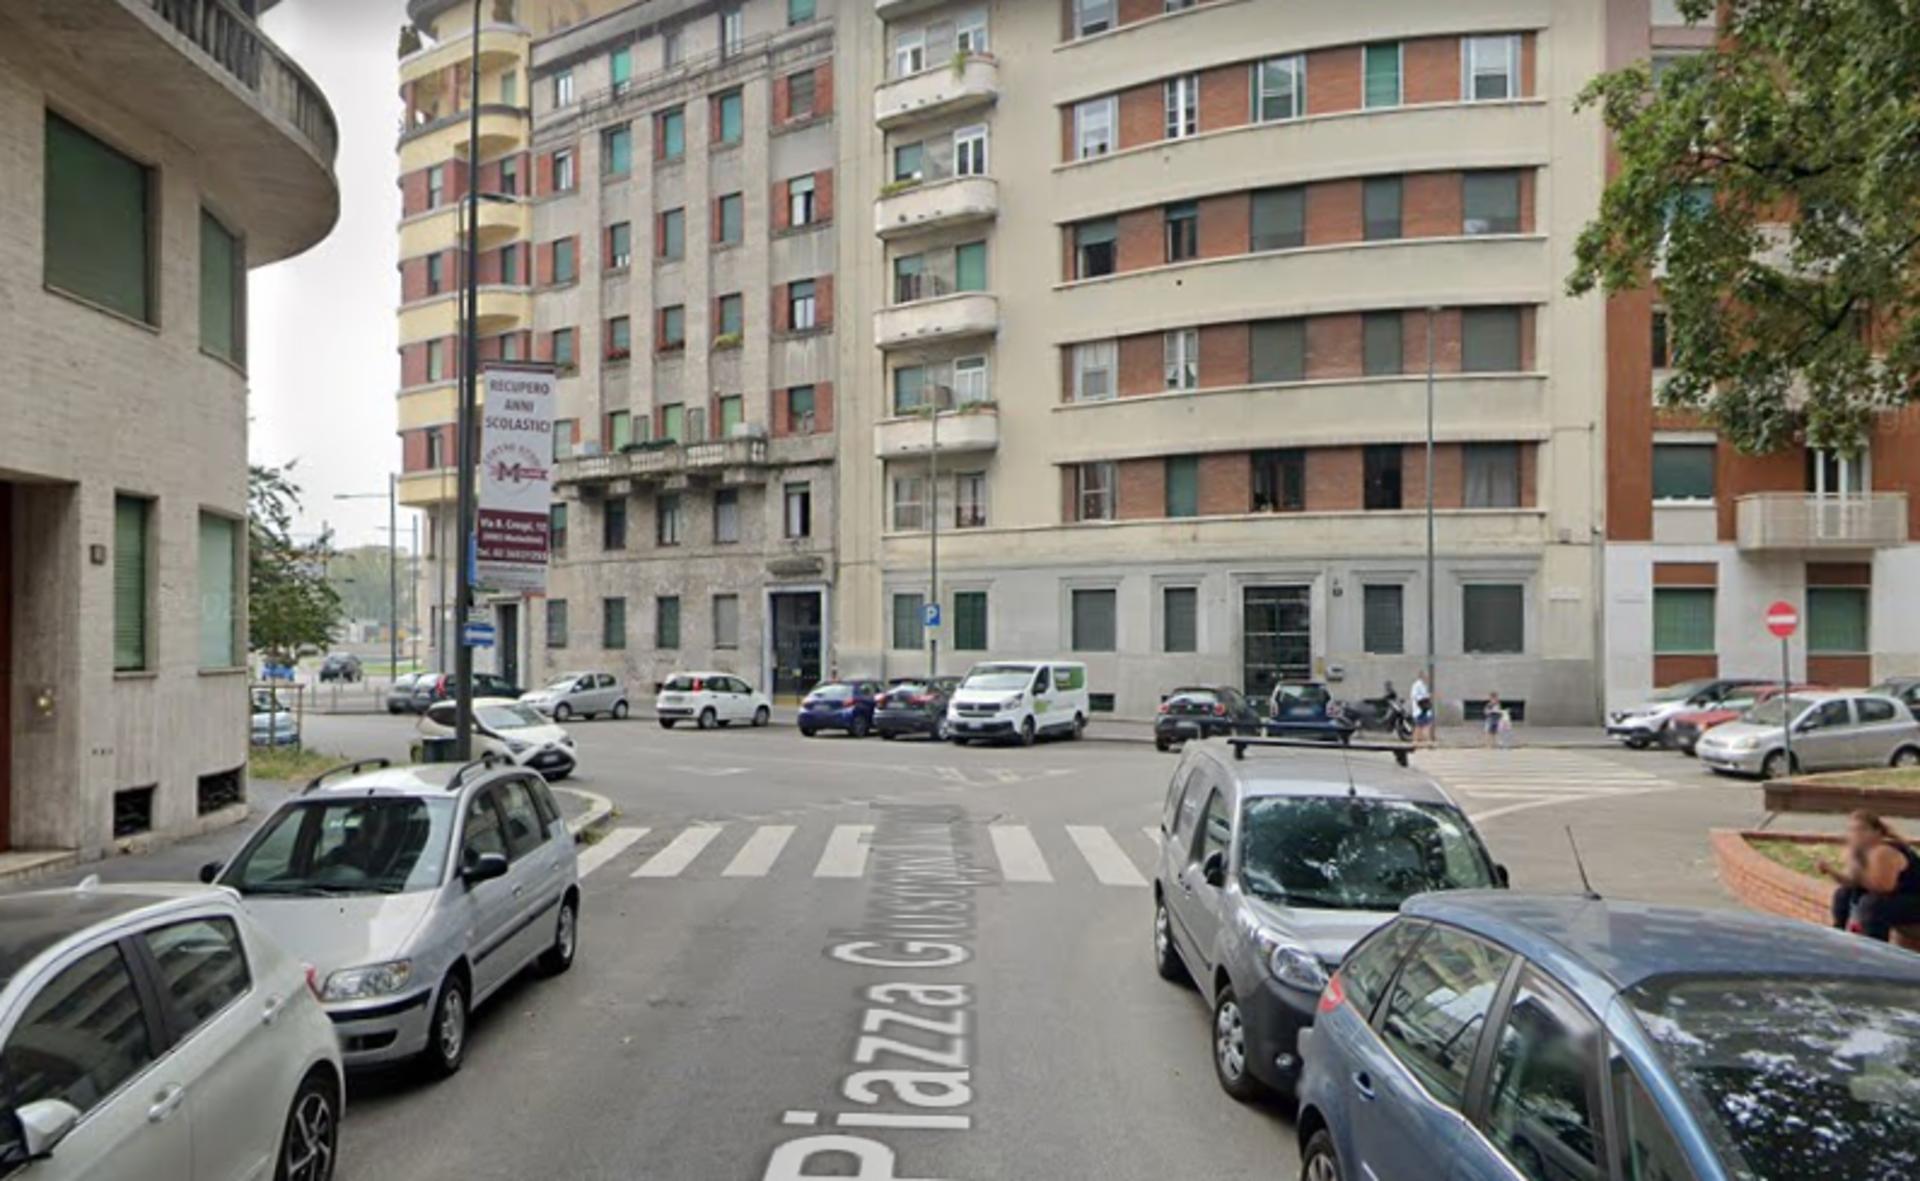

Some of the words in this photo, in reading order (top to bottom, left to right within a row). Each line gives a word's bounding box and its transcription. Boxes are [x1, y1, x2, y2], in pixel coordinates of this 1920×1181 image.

[490, 379, 550, 396] RECUPERO
[504, 399, 535, 413] ANNI
[485, 416, 552, 433] SCOLASTICI
[925, 605, 939, 625] P
